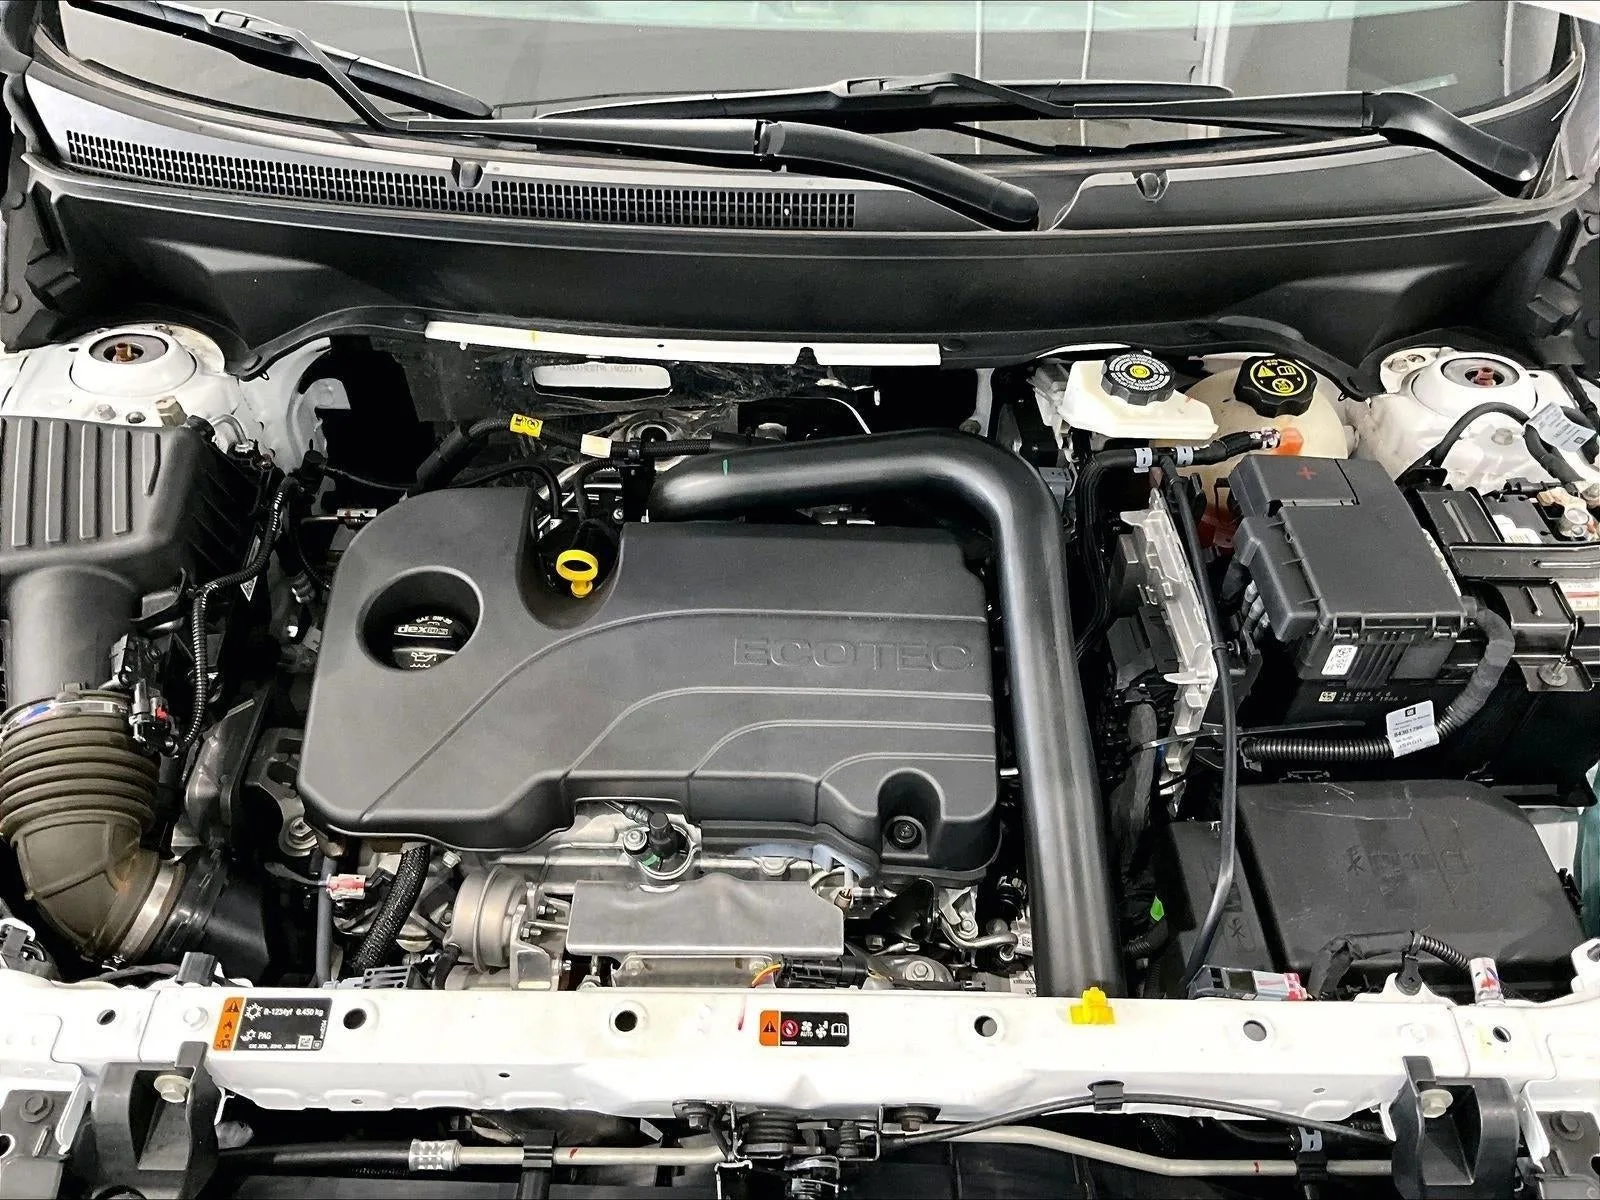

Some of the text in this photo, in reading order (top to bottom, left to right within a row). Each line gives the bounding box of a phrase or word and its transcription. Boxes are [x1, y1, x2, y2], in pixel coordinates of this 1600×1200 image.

[733, 637, 973, 672] ECOTEC
[263, 1008, 294, 1017] R-1234yf
[257, 1031, 272, 1041] PAG
